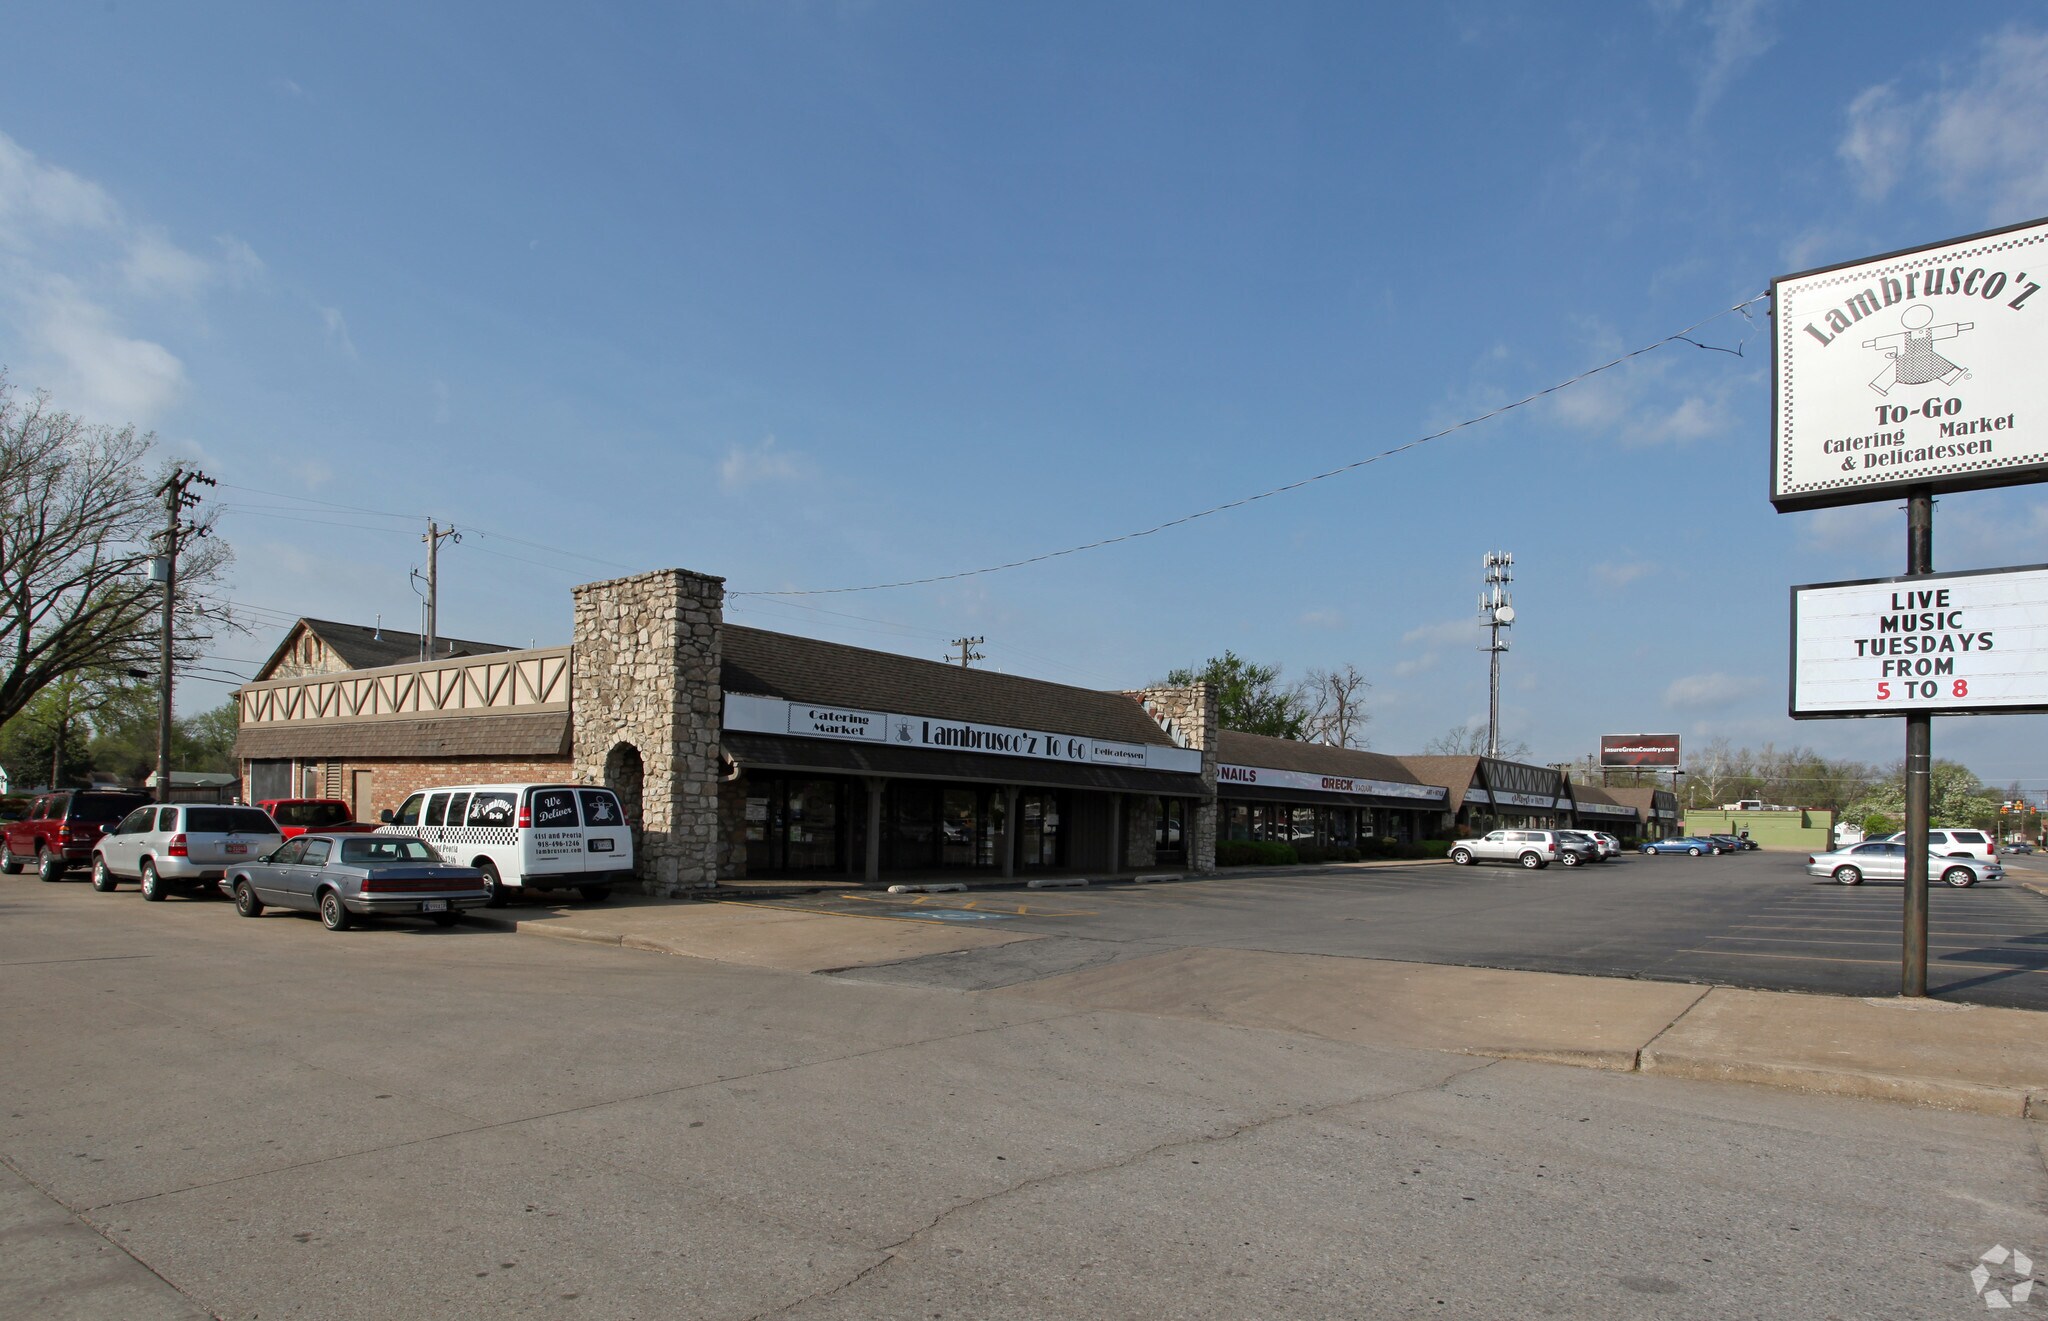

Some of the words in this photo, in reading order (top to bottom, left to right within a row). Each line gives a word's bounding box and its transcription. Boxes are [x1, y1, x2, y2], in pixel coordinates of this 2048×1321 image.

[1803, 266, 2041, 347] Lambrusco'z
[1875, 397, 1962, 426] To-Go
[1939, 413, 2014, 438] Market
[1823, 429, 1905, 455] Catering
[1841, 455, 1857, 472] &
[1864, 439, 1992, 469] Delicatessen
[1892, 589, 1949, 611] LIVE
[1880, 611, 1962, 633] MUSIC
[1854, 632, 1993, 656] TUESDAYS
[1882, 657, 1954, 677] FROM
[1877, 682, 1891, 700] 5
[1904, 681, 1938, 699] TO
[1952, 679, 1968, 698] 8
[809, 709, 869, 725] Catering
[812, 723, 864, 736] Market
[922, 721, 1037, 754] Lambrusco'z
[1045, 735, 1061, 756] To
[1068, 738, 1085, 760] Go
[1094, 747, 1144, 760] Delicatessen
[1221, 767, 1256, 782] NAILS
[1321, 777, 1353, 791] ORECK
[544, 796, 562, 808] We
[539, 807, 572, 822] Deliver
